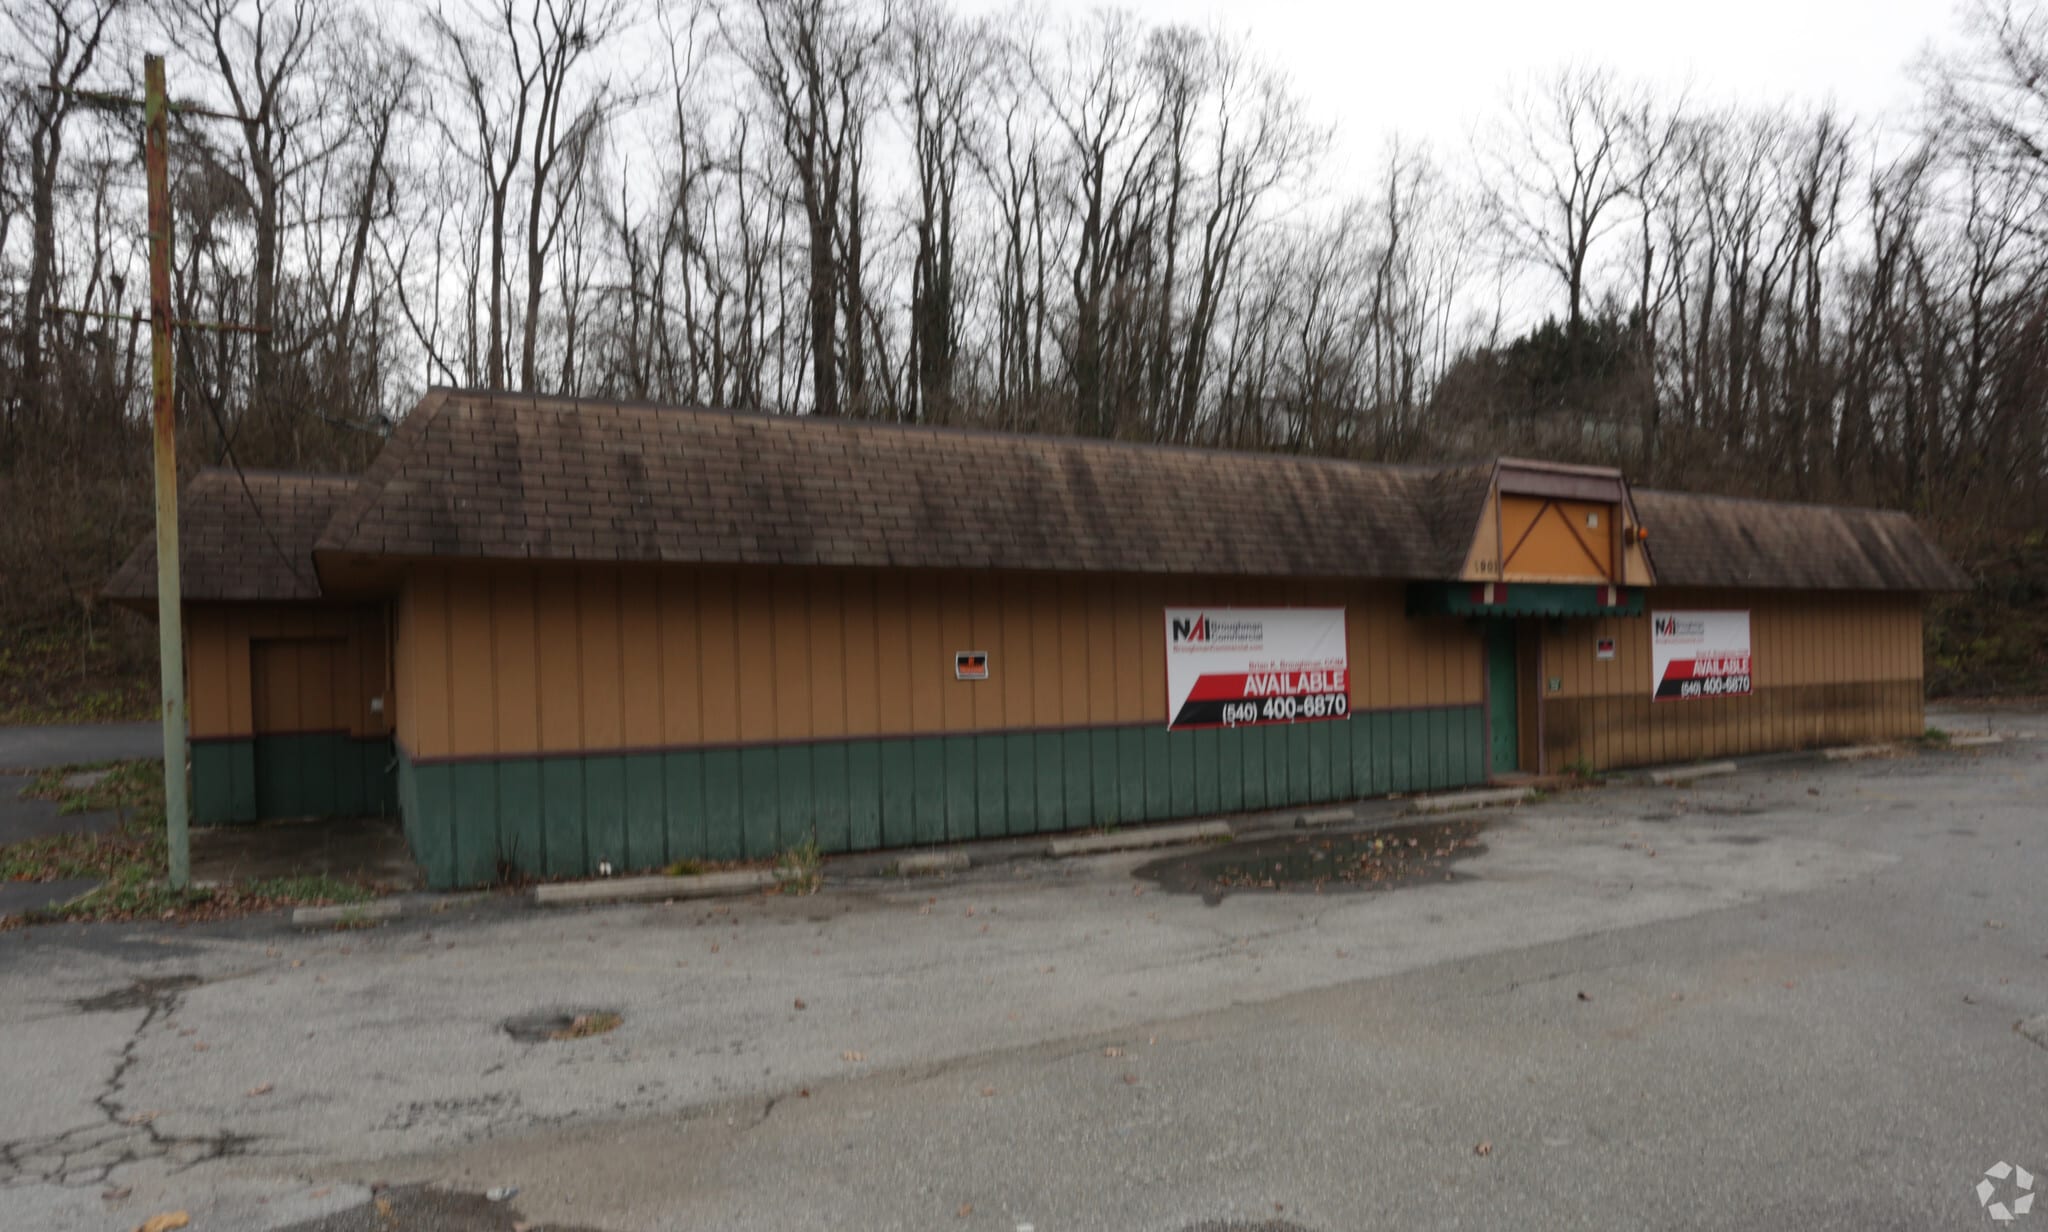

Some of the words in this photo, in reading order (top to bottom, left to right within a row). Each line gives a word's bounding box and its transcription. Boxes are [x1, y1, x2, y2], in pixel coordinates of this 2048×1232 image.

[1173, 612, 1210, 642] NAI
[1656, 616, 1676, 636] NAI
[1693, 657, 1749, 677] AVAILABLE
[1243, 671, 1345, 696] AVAILABLE
[1222, 702, 1258, 725] (540)
[1262, 693, 1347, 719] 400-6870
